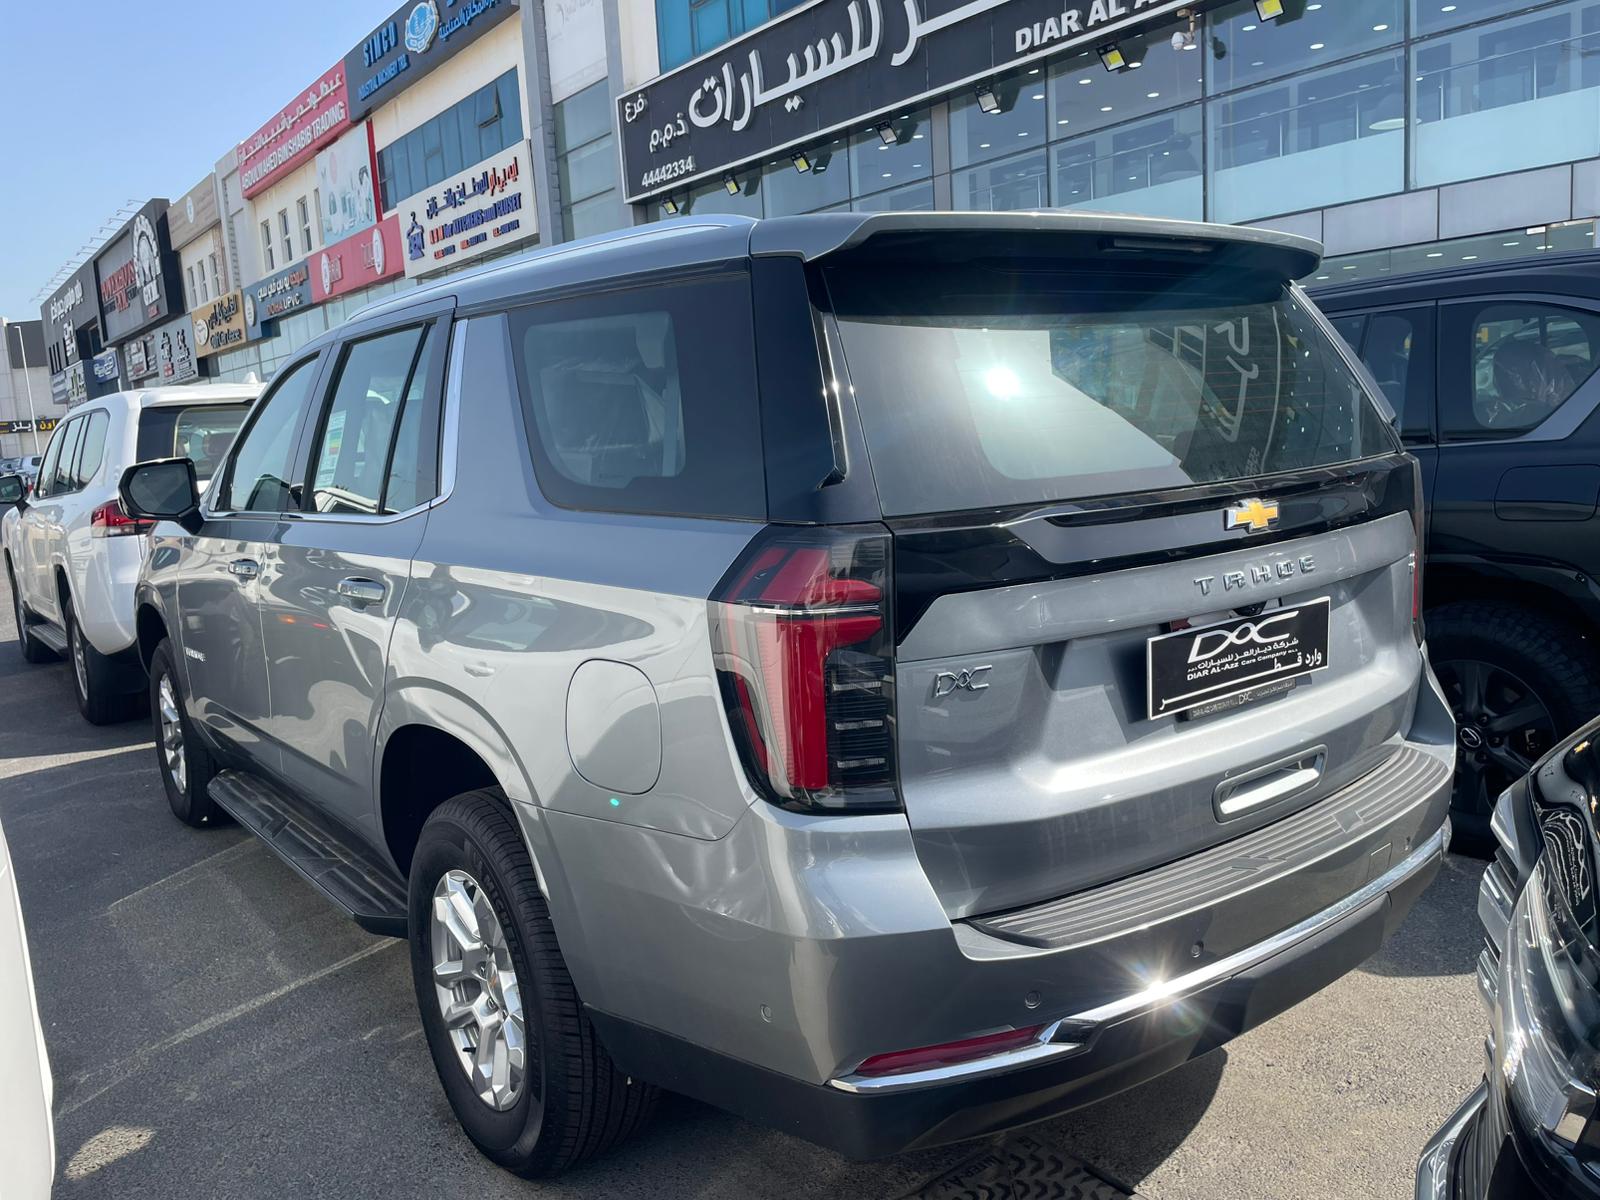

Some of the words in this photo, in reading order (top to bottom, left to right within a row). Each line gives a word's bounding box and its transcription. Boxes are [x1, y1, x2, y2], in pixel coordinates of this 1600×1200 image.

[1015, 9, 1081, 53] DIAR
[1087, 0, 1127, 27] AL
[363, 21, 398, 67] SIMCO
[625, 94, 645, 123] فرع
[288, 125, 313, 158] SHABIB
[312, 101, 346, 141] TRADING
[641, 155, 694, 188] 44442334
[496, 192, 522, 218] CLOSET
[283, 293, 302, 310] UPVC
[1193, 555, 1316, 596] TAHOE
[1273, 637, 1299, 649] شركة
[1305, 648, 1322, 667] وارد
[1187, 670, 1210, 680] DIAR
